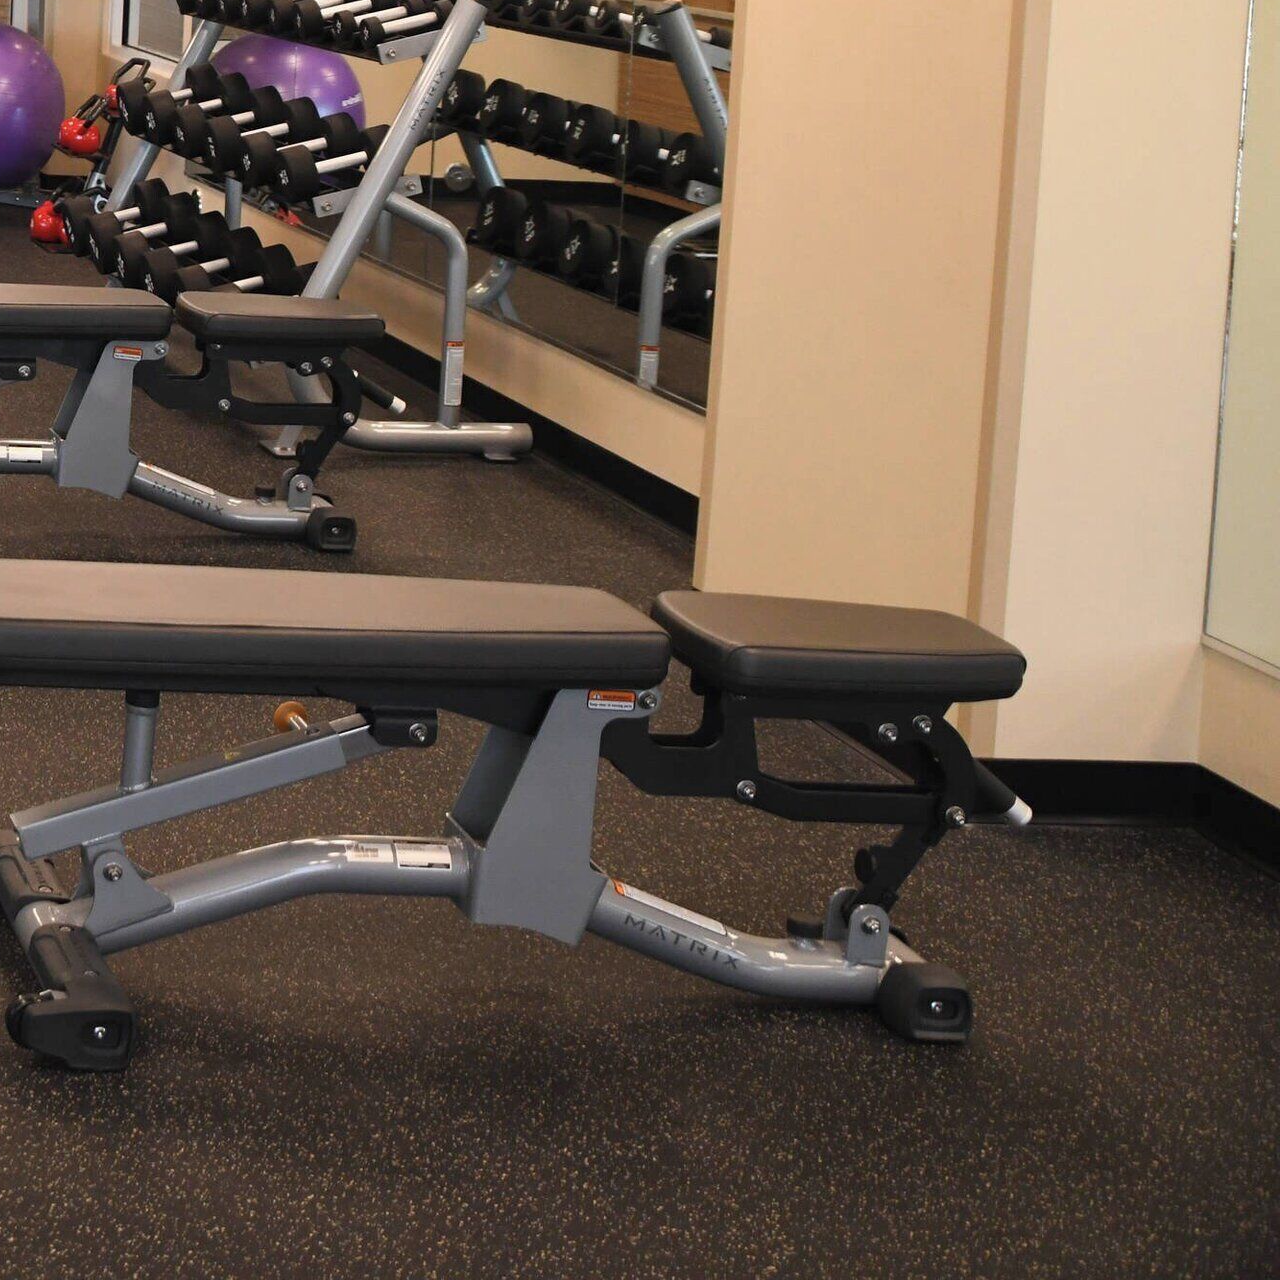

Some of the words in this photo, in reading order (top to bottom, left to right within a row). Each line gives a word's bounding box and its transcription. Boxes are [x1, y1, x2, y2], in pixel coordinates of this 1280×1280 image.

[411, 70, 446, 130] MATRIX
[152, 481, 224, 515] MATRIX
[624, 914, 740, 970] MATRIX
